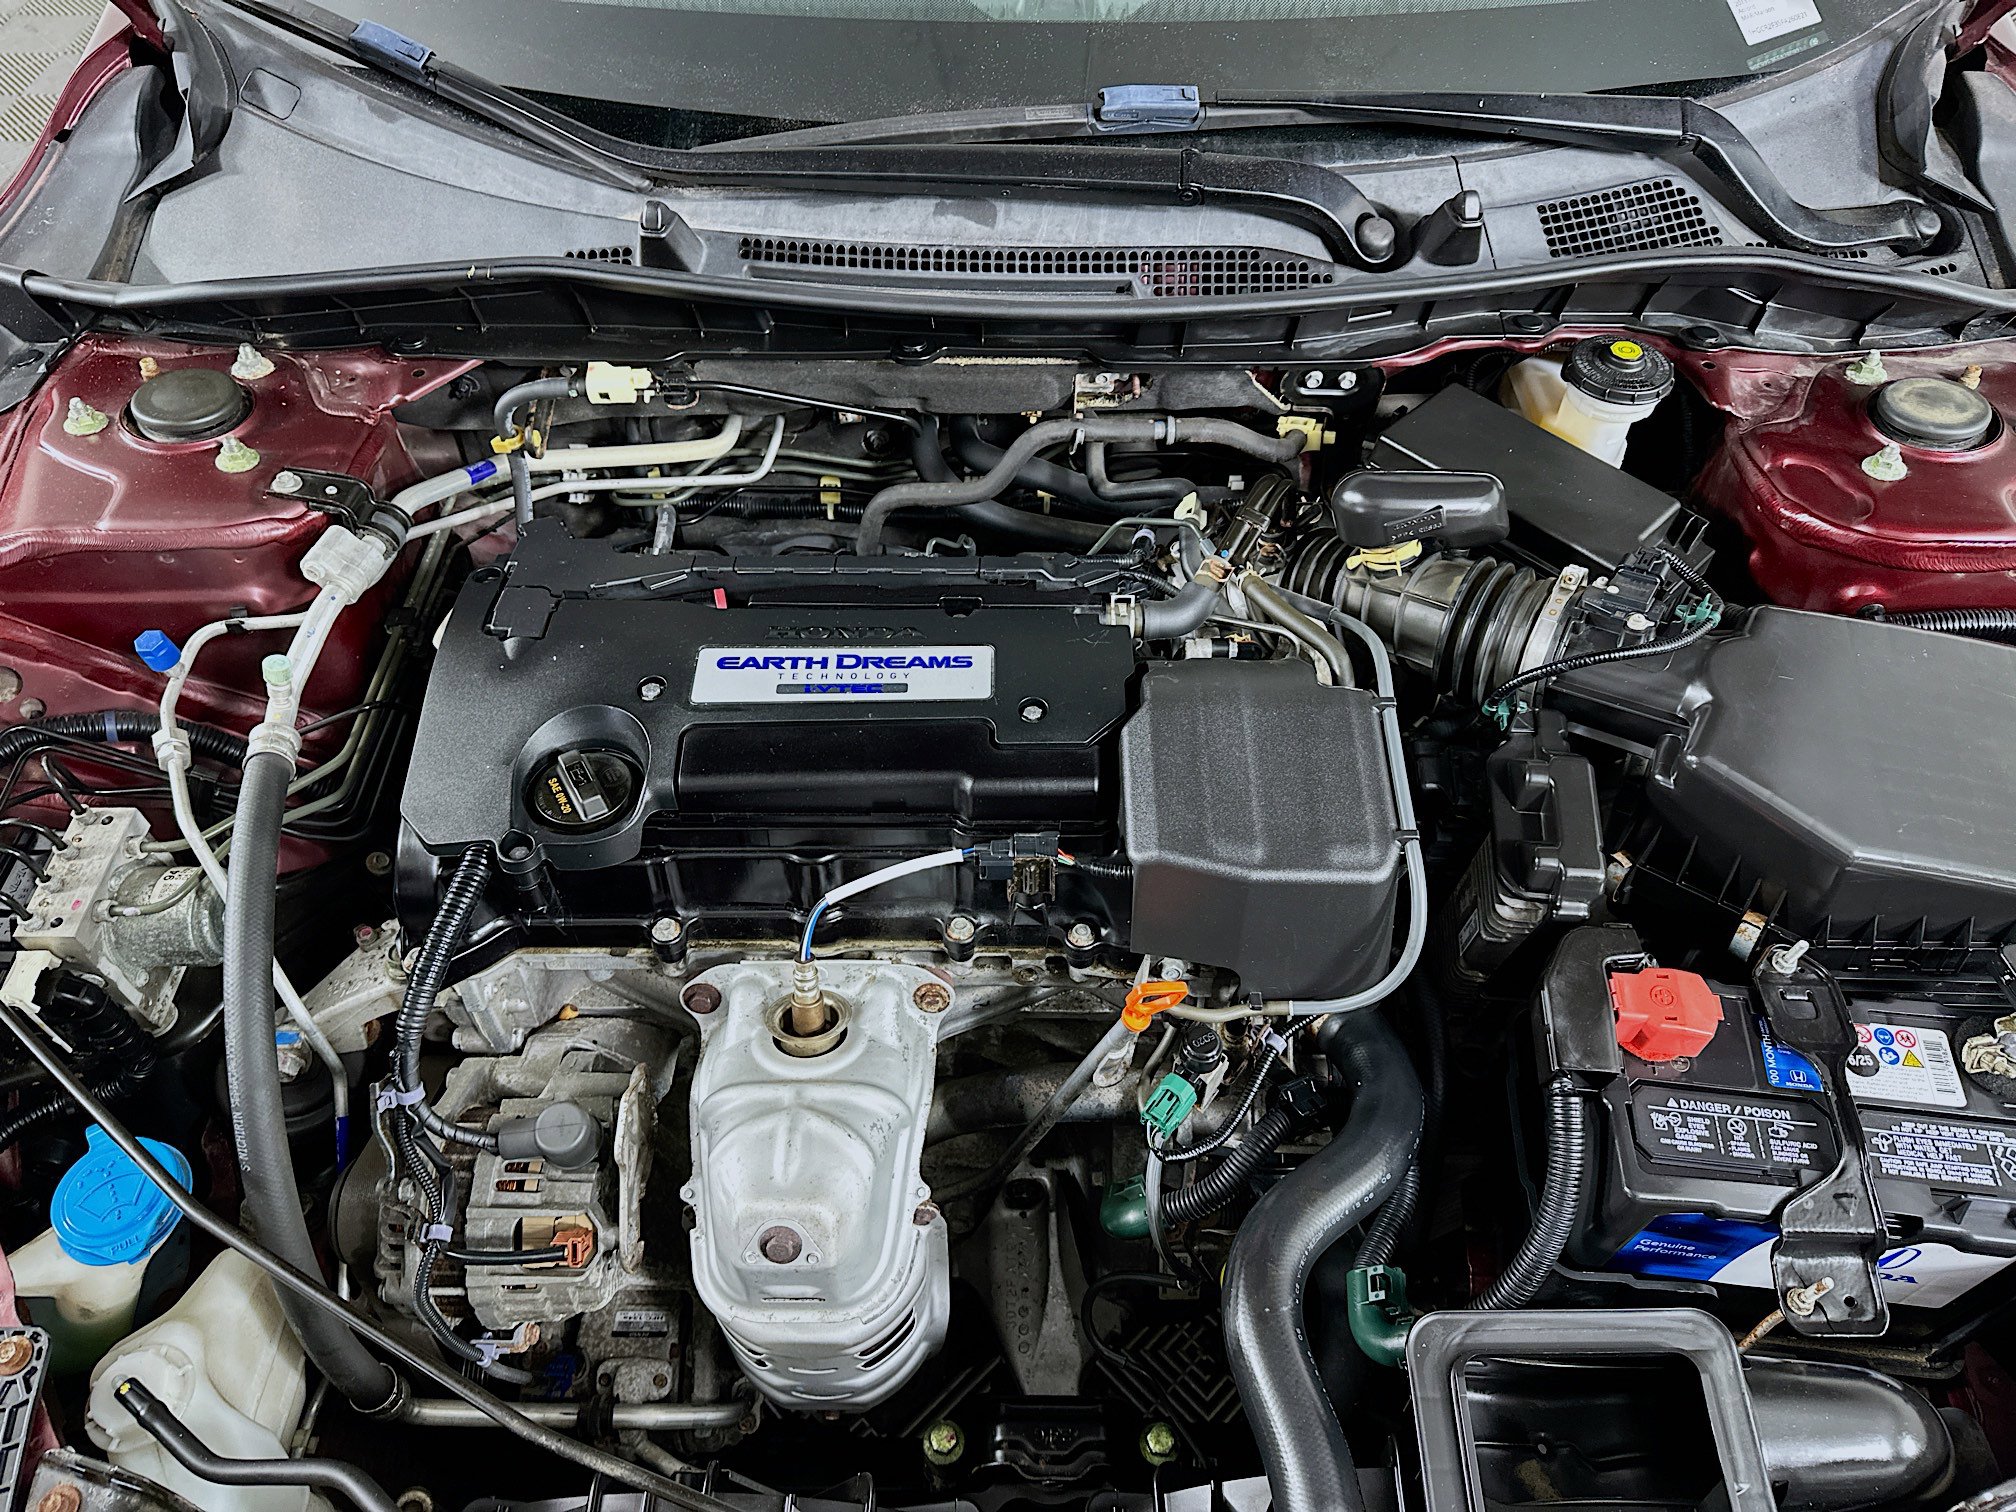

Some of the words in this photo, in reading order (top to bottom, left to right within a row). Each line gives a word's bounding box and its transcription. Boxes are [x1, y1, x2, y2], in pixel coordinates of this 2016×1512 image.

[764, 626, 928, 639] HONDA
[716, 656, 830, 670] EARTH
[836, 654, 974, 669] DREAMS
[778, 672, 911, 681] TECHNOLOGY
[547, 777, 560, 794] SAE
[1762, 1034, 1777, 1068] MONTH
[1769, 1069, 1779, 1084] 100
[1785, 1081, 1814, 1089] HONDA
[1679, 1099, 1731, 1114] DANGER
[1744, 1106, 1791, 1120] POISON
[1686, 1116, 1711, 1124] SHIELD
[1674, 1127, 1710, 1137] EXPLOSIVE
[1675, 1133, 1698, 1141] GASES
[1769, 1138, 1802, 1148] SULFURIC
[1802, 1142, 1818, 1150] ACID
[1892, 1135, 1915, 1144] FLUSH
[1915, 1137, 1933, 1146] EYES
[1897, 1148, 1926, 1158] MEDICAL
[1927, 1152, 1944, 1160] HELP
[1944, 1153, 1962, 1162] FAST
[110, 1235, 143, 1256] PULL
[1640, 1237, 1696, 1251] Genuine
[1634, 1244, 1717, 1261] Performance
